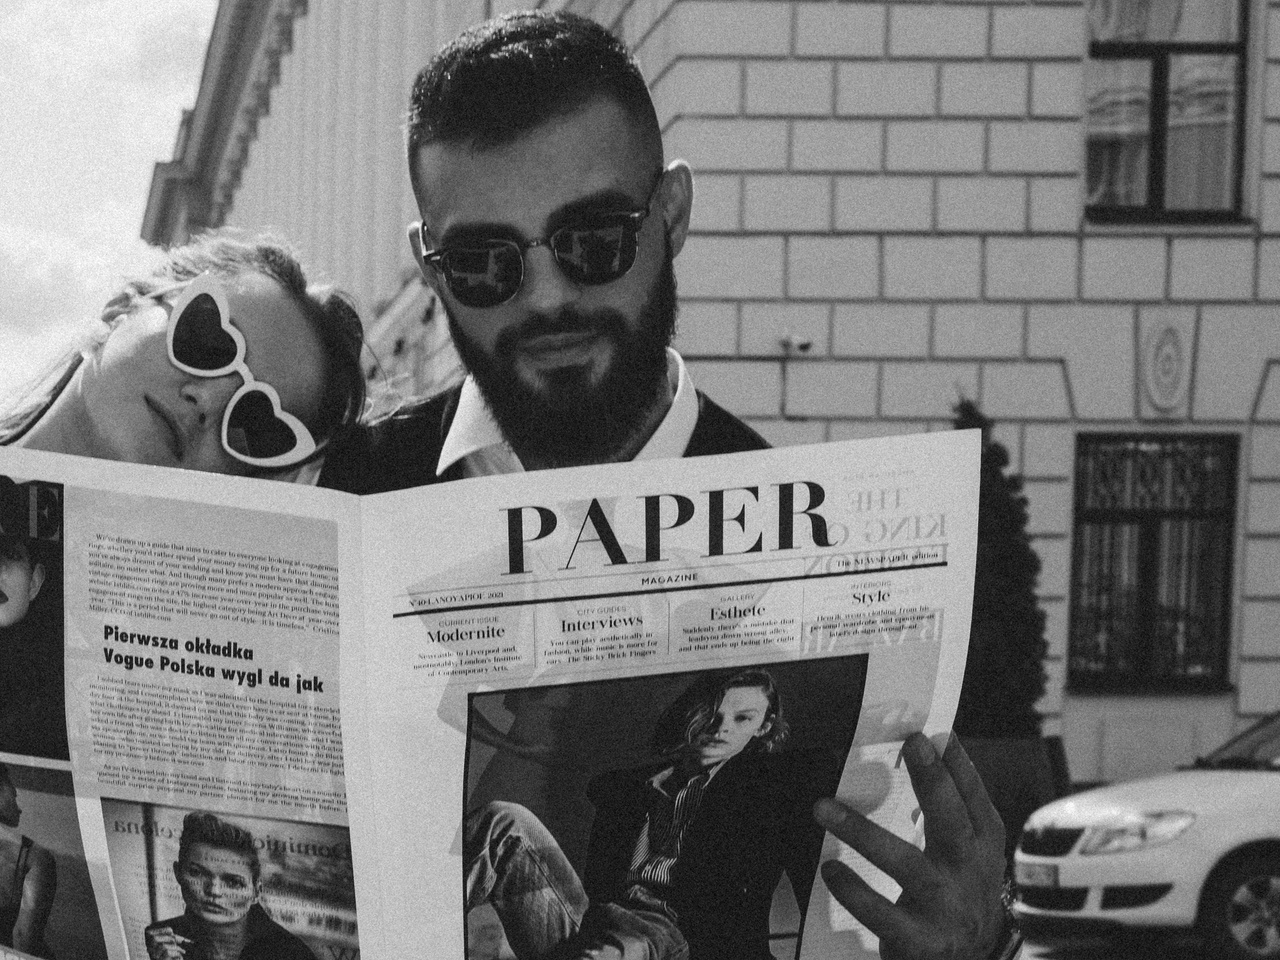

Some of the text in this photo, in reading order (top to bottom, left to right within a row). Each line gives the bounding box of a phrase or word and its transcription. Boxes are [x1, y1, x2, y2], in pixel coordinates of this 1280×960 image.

[498, 480, 839, 576] PAPER
[115, 535, 293, 567] drawn guide that aims cater everyone looking
[110, 553, 131, 564] always
[132, 556, 156, 566] dreamt
[182, 563, 210, 575] wedding
[225, 568, 243, 577] know
[278, 575, 293, 584] have
[295, 577, 309, 586] that
[310, 579, 339, 590] diamond
[154, 550, 174, 559] rather
[176, 554, 196, 562] spend
[214, 559, 236, 569] money
[238, 562, 259, 572] saving
[271, 565, 280, 573] for
[288, 567, 308, 577] future
[126, 565, 314, 595] matter And though many prefer modern approach
[641, 572, 699, 586] MAGAZINE
[151, 577, 168, 587] rings
[180, 582, 206, 592] proving
[258, 592, 284, 601] popular
[311, 597, 324, 606] The
[851, 590, 891, 607] Style
[154, 595, 165, 603] the
[181, 598, 192, 606] the
[218, 604, 246, 615] category
[247, 607, 266, 618] being
[267, 610, 279, 618] Art
[160, 604, 174, 613] that
[176, 607, 188, 615] will
[278, 602, 290, 610] the
[291, 606, 321, 615] purchase
[710, 605, 766, 621] Esthete
[867, 609, 897, 618] clothing
[899, 606, 916, 614] from
[561, 615, 644, 633] Interviews
[682, 625, 715, 634] Suddenly
[842, 619, 878, 628] wardrobe
[427, 626, 505, 643] Modernite
[599, 632, 642, 643] aesthetically
[721, 632, 742, 640] down
[741, 638, 761, 647] being
[103, 625, 254, 661] Pierwsza okładka
[574, 646, 593, 654] while
[465, 647, 500, 657] Liverpool
[493, 655, 522, 663] Institute
[103, 647, 324, 694] Vogue Polska wygl da jak
[199, 790, 292, 807] partner for the
